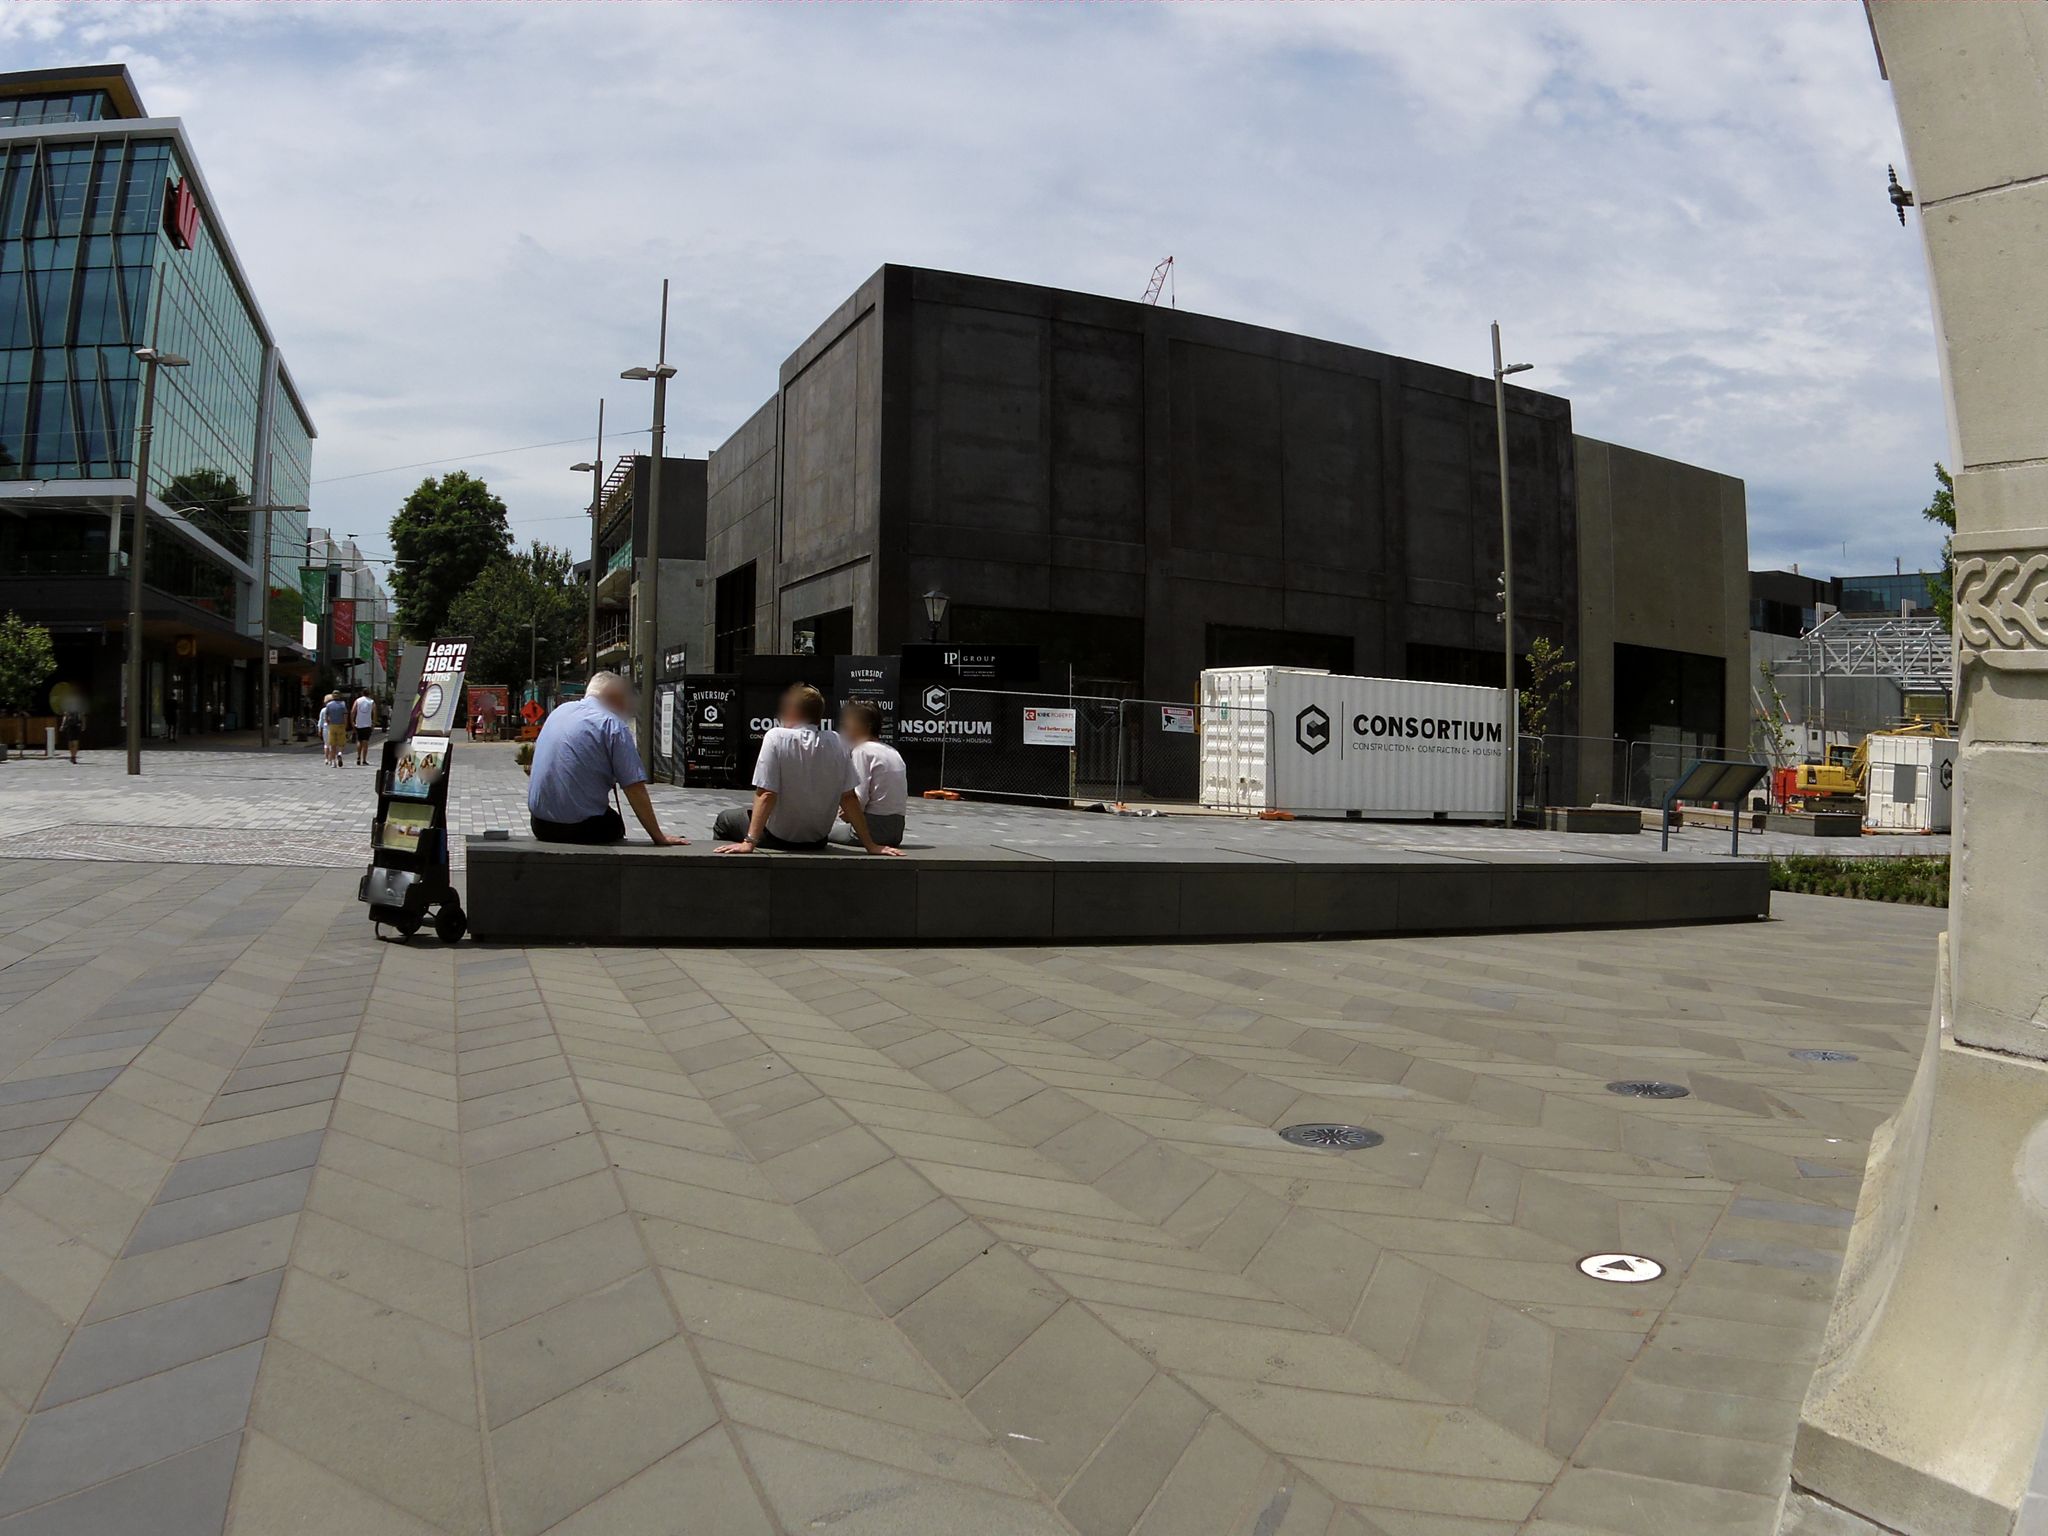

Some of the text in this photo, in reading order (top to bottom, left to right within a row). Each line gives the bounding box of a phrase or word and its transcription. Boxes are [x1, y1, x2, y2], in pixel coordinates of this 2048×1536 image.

[429, 642, 467, 656] Learn
[425, 656, 464, 672] BIBLE
[944, 652, 958, 665] IP
[422, 673, 451, 682] TRUTHS
[850, 669, 884, 679] RIVERSIDE
[693, 690, 730, 701] RIVERSIDE
[877, 700, 894, 711] YOU
[898, 720, 992, 734] NSORTIUM
[1353, 714, 1502, 743] CONSORTIUM
[1352, 742, 1502, 757] CONSTRUCTION CONTRACTING HOUSING
